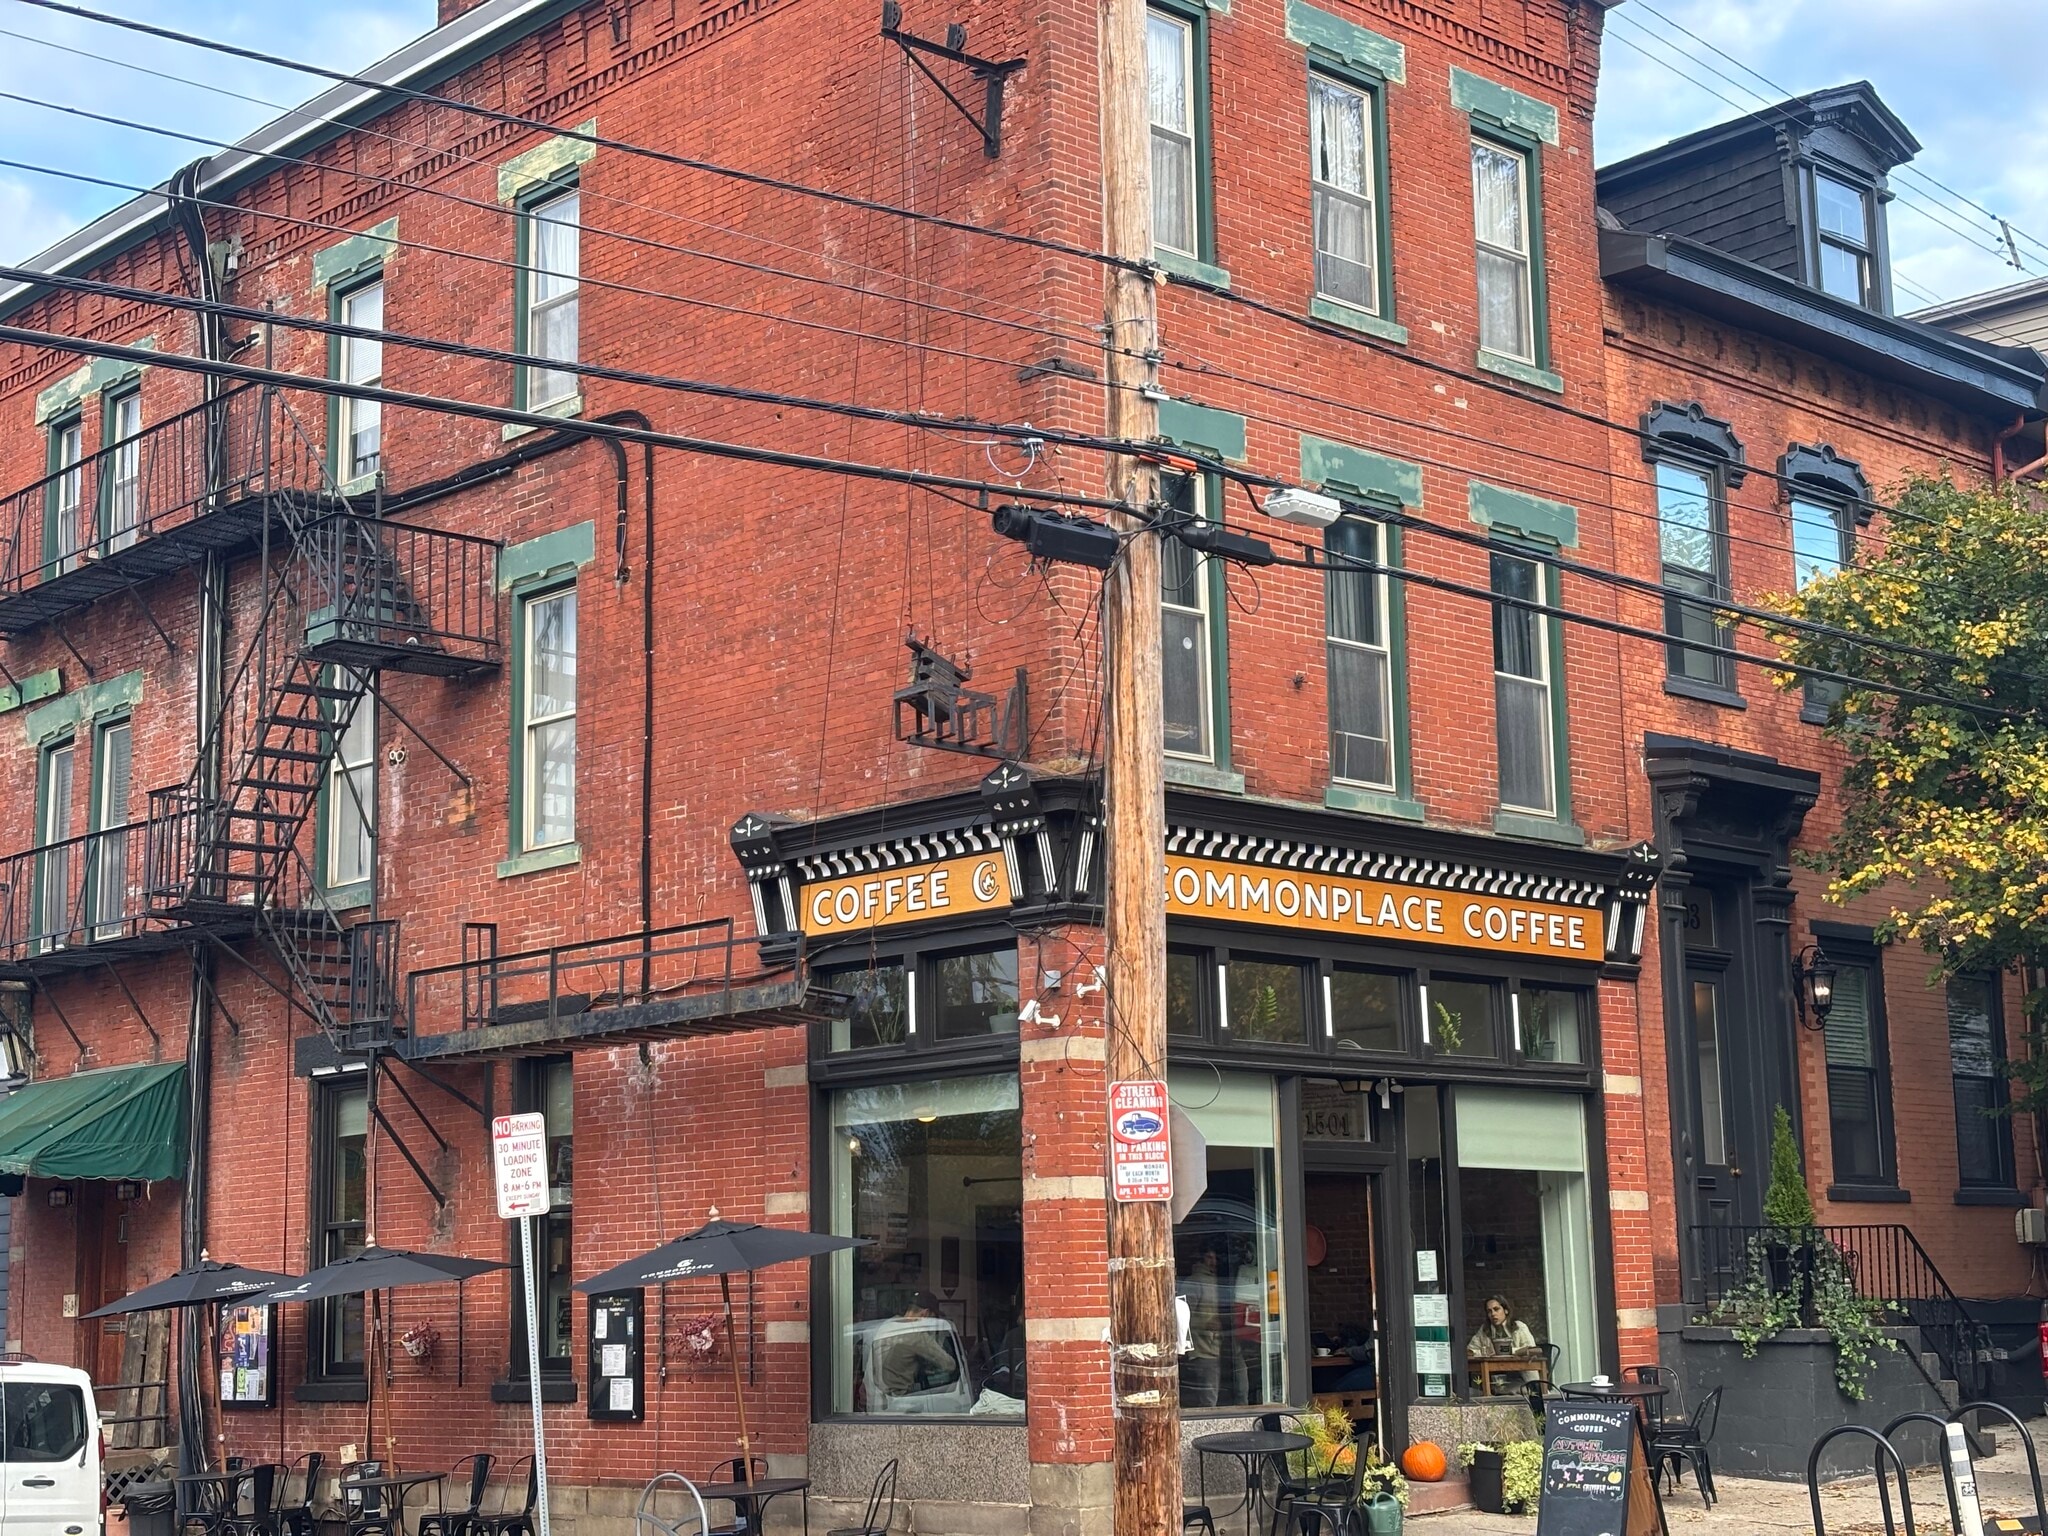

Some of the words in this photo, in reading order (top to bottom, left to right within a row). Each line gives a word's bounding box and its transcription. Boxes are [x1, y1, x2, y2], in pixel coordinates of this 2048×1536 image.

[812, 869, 951, 927] COFFEE
[1164, 864, 1444, 934] OMMONPLACE
[1462, 903, 1586, 951] COFFEE
[1119, 1085, 1155, 1097] STREET
[1115, 1097, 1163, 1109] CLEANING
[494, 1120, 511, 1136] NO
[511, 1120, 540, 1133] PARKING
[1305, 1110, 1350, 1137] 1501
[498, 1143, 508, 1153] 30
[512, 1140, 540, 1152] MINUTE
[1116, 1142, 1128, 1153] NO
[1130, 1141, 1167, 1153] PARKING
[503, 1153, 537, 1166] LOADING
[1128, 1152, 1143, 1161] THIS
[1144, 1151, 1165, 1160] BLOCK
[511, 1167, 532, 1178] ZONE
[503, 1183, 509, 1193] 8
[1558, 1413, 1622, 1428] COMMONPLACE
[1573, 1424, 1604, 1433] COFFEE
